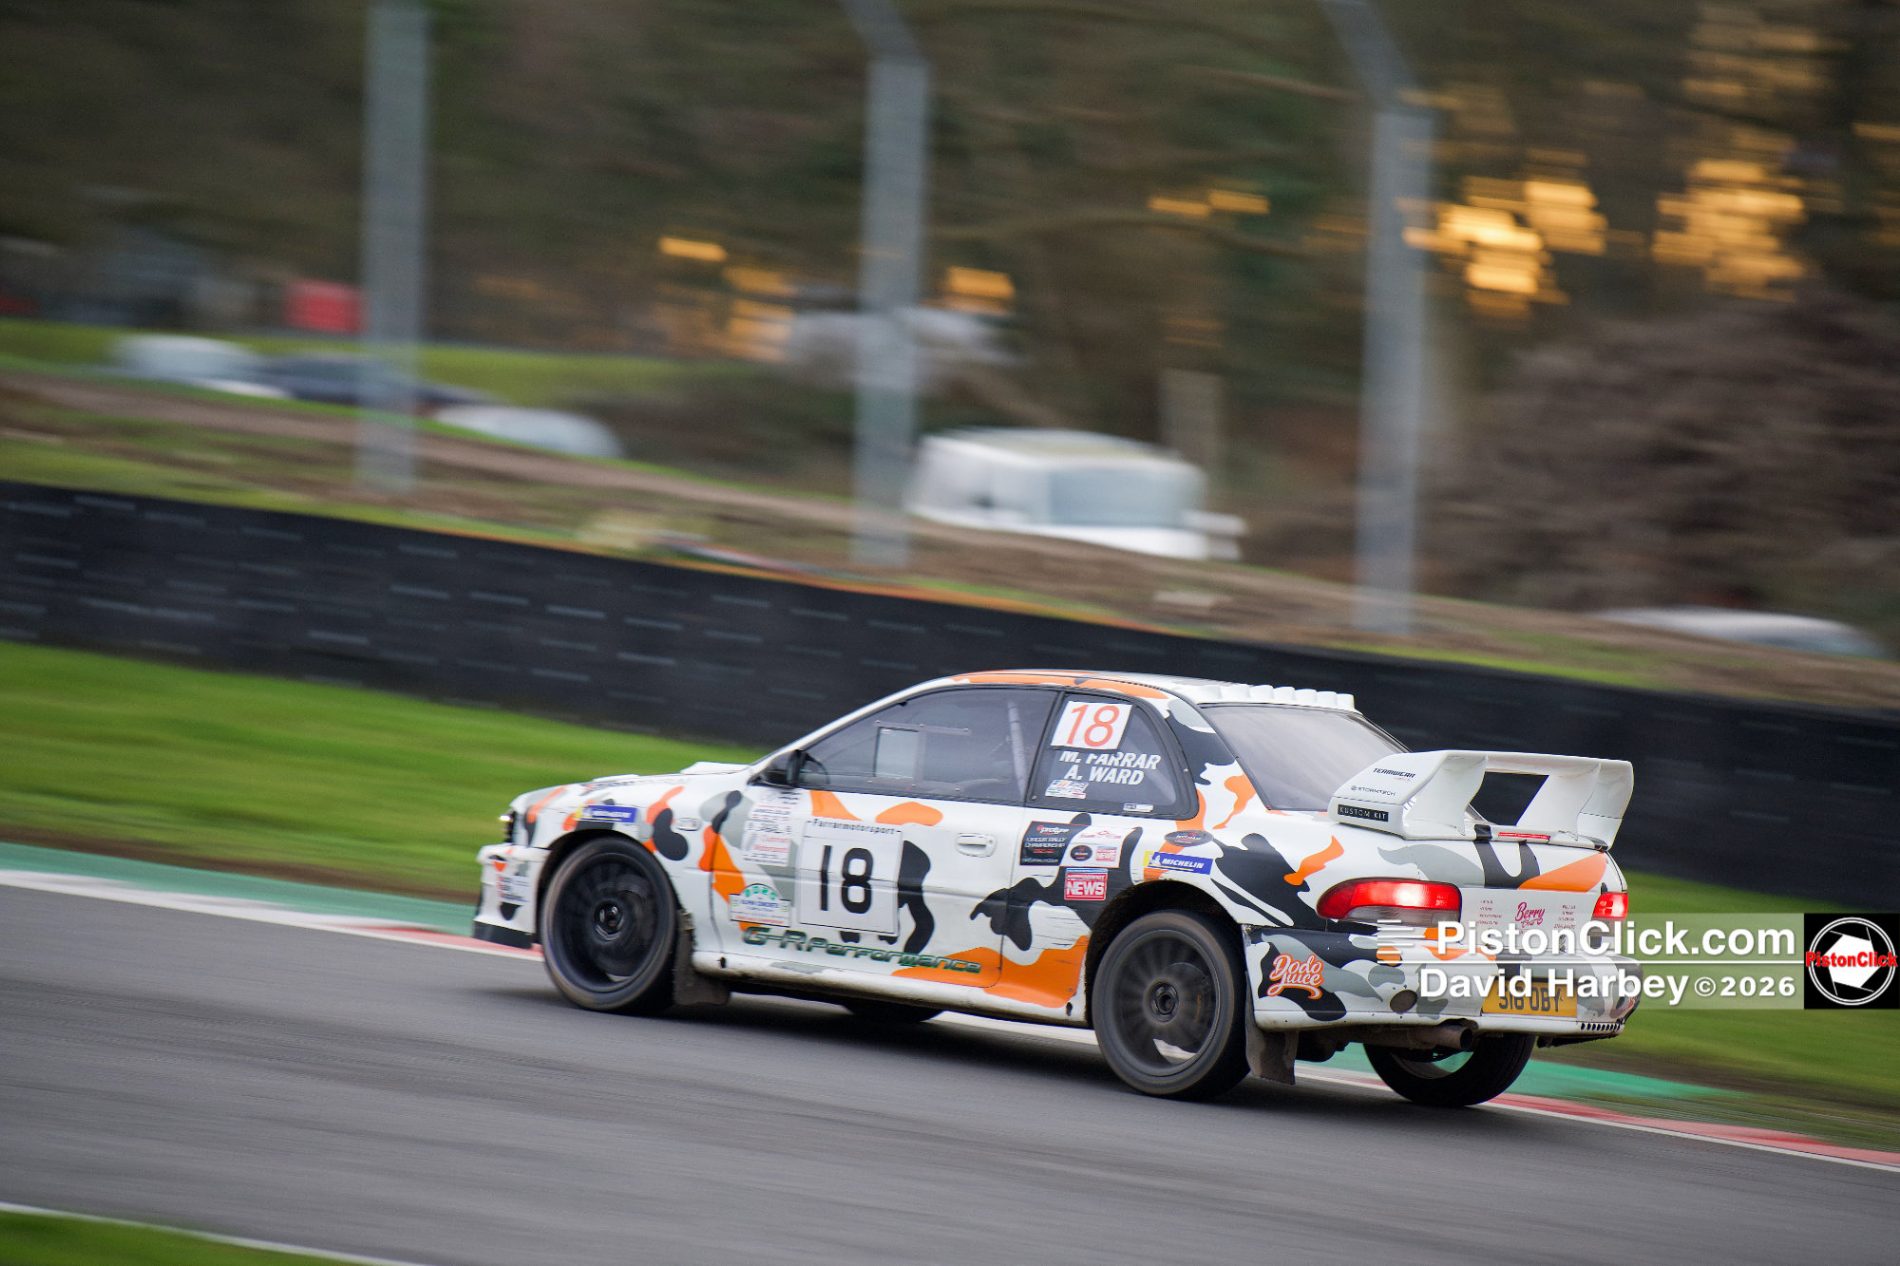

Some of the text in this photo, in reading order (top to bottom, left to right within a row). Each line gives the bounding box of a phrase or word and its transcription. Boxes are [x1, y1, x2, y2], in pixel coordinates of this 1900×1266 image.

[1066, 704, 1120, 747] 18
[1085, 751, 1161, 770] FARRAR
[1064, 764, 1144, 785] A. WARD
[1339, 806, 1386, 820] KUSTOM KIT
[1162, 858, 1205, 869] MICHELIN
[820, 844, 874, 915] 18
[1066, 881, 1105, 896] NEWS
[1514, 901, 1546, 926] Berry
[1269, 953, 1324, 981] Dodo
[1267, 970, 1324, 1000] Juice
